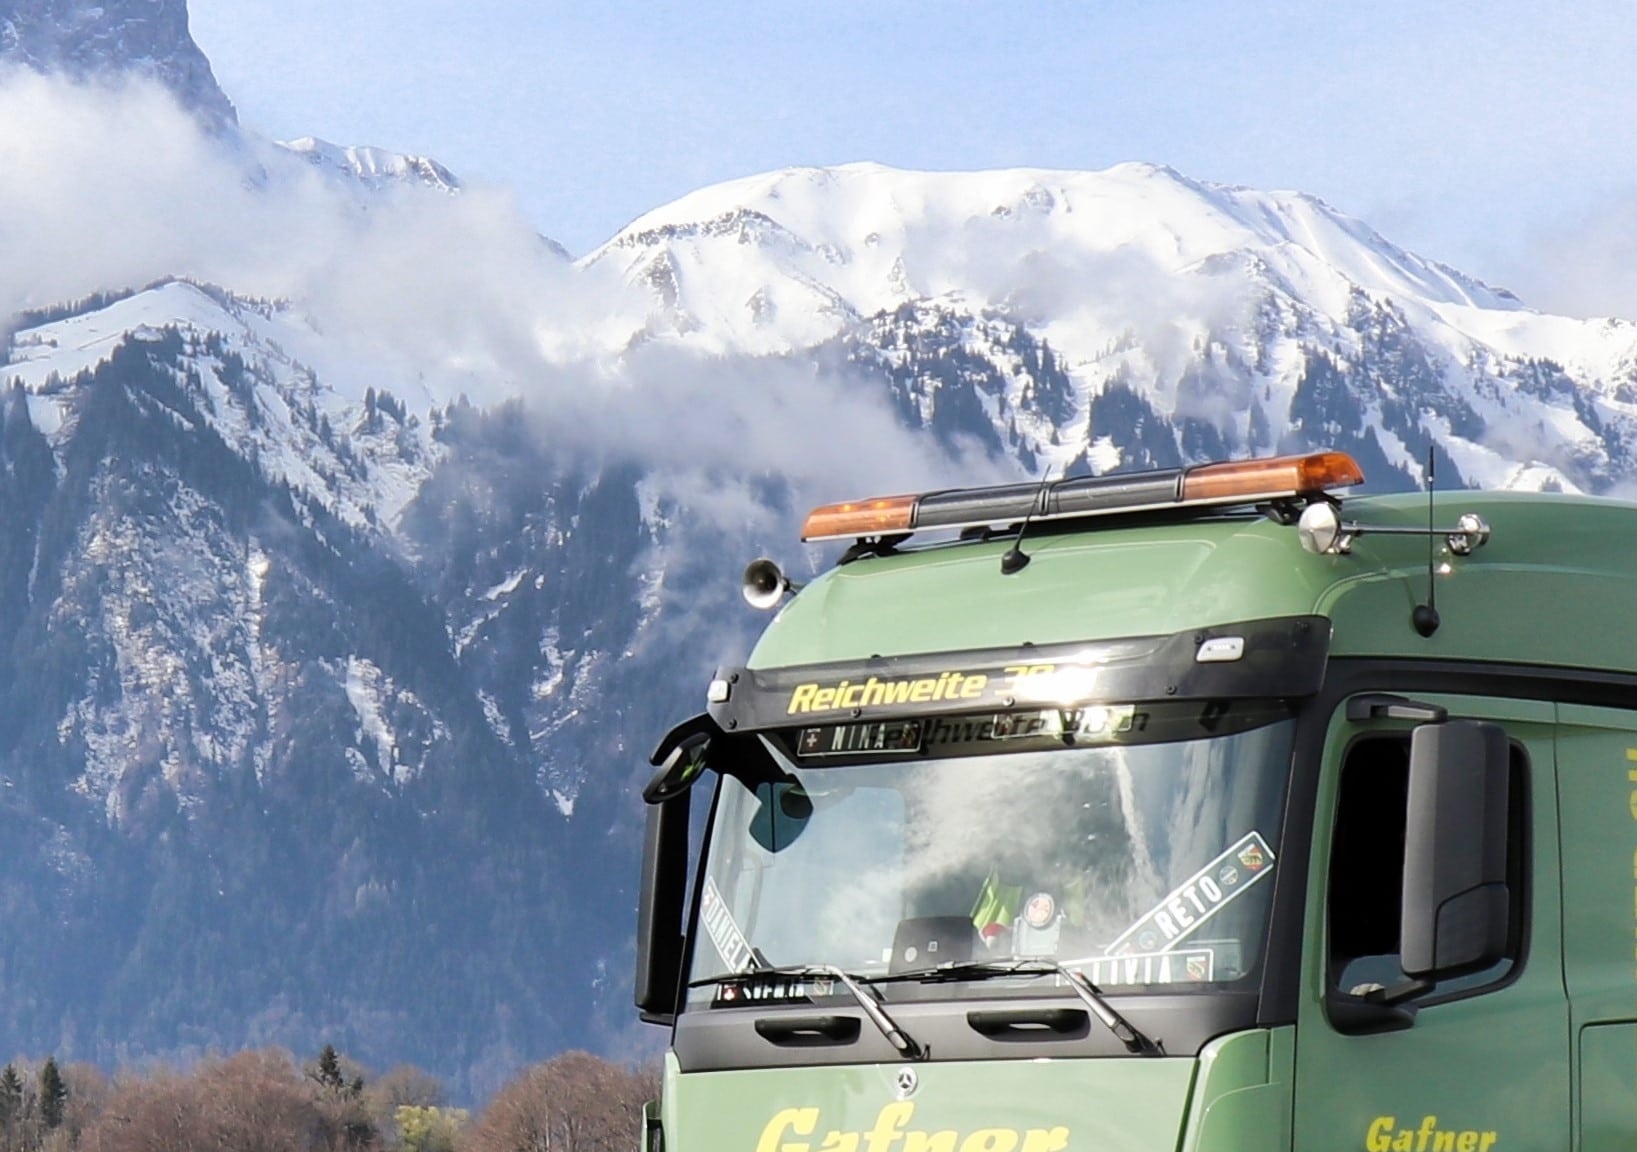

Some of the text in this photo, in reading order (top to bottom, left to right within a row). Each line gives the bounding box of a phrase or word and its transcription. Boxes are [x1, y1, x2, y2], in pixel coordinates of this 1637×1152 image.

[787, 671, 988, 715] Reichweite
[832, 723, 886, 751] NINA
[1153, 875, 1223, 941] RETO
